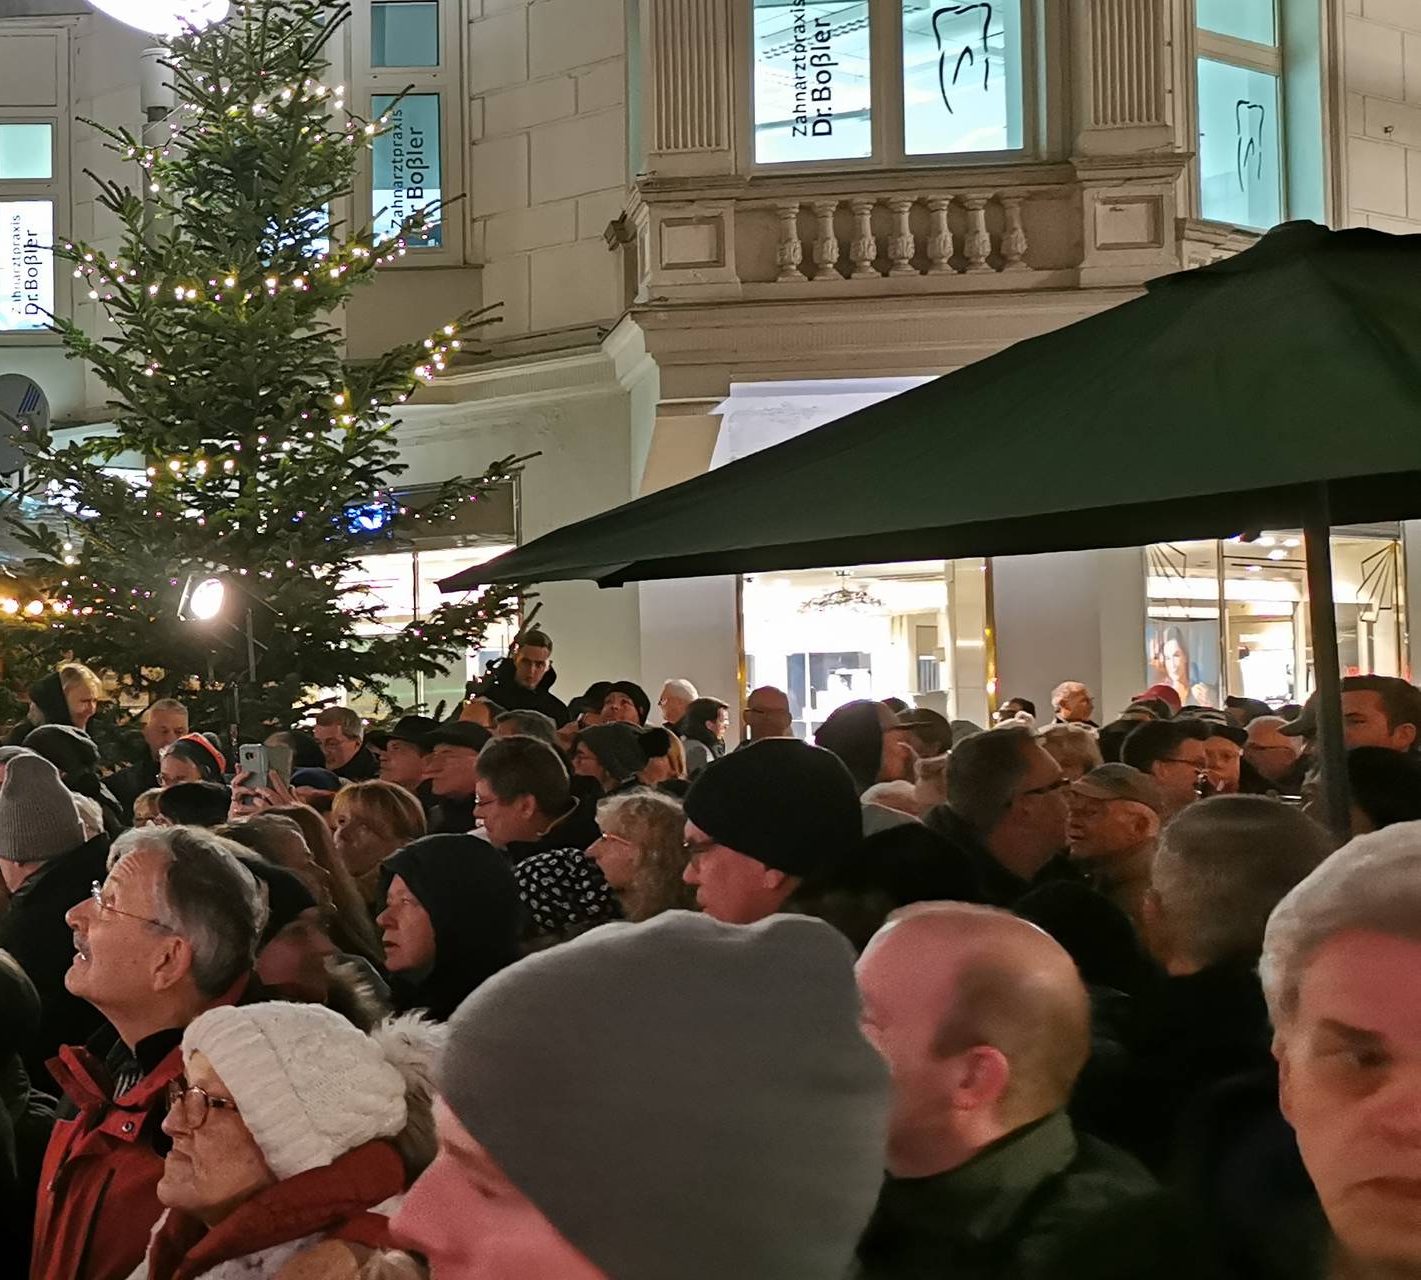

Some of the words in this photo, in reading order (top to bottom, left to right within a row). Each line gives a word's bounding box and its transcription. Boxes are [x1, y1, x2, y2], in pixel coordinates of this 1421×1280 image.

[790, 0, 807, 137] Zahnarztpraxis
[810, 18, 839, 101] Boßler
[391, 109, 405, 229] Zahnarztpraxis
